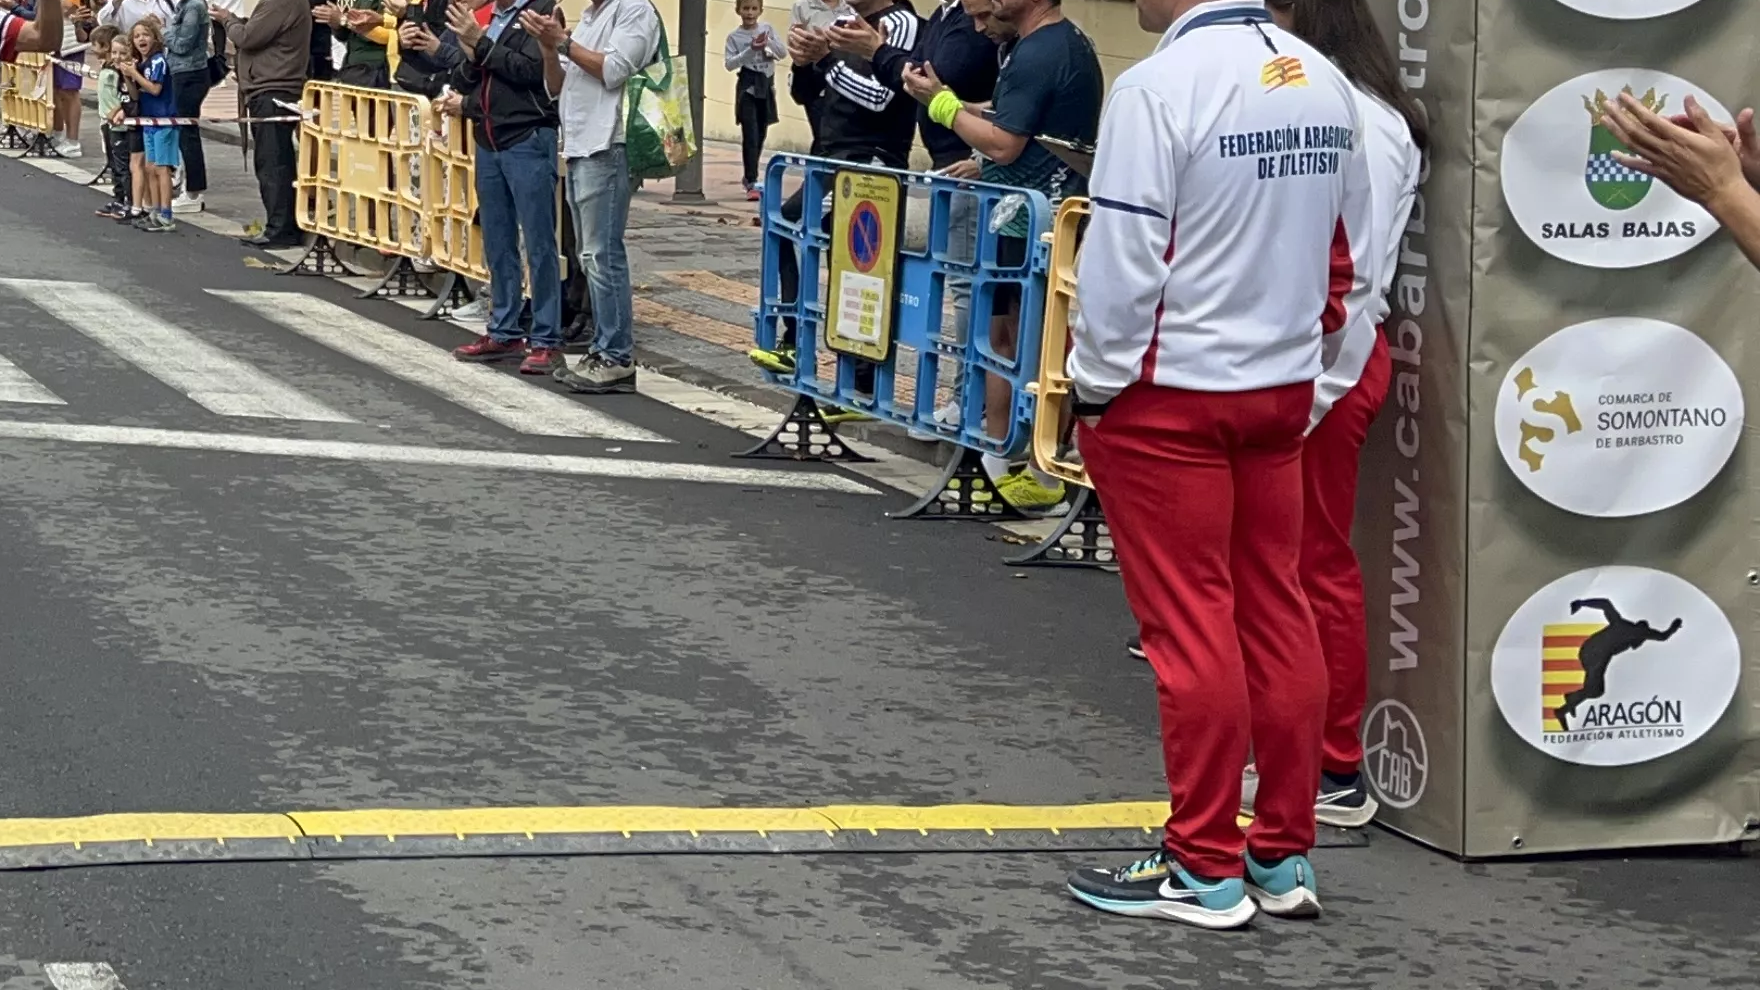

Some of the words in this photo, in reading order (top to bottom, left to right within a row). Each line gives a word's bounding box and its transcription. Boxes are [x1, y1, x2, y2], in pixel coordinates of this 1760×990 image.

[1219, 124, 1300, 158] FEDERACIÓN
[1258, 156, 1275, 180] DE
[1541, 223, 1610, 239] SALAS
[1622, 222, 1696, 238] BAJAS
[1598, 392, 1655, 405] COMARCA
[1658, 392, 1673, 403] DE
[1597, 407, 1726, 430] SOMONTANO
[1596, 437, 1611, 449] DE
[1615, 434, 1684, 447] BARBASTRO
[1582, 695, 1682, 728] ARAGÓN
[1543, 730, 1614, 744] FEDERACIÓN
[1618, 728, 1685, 741] ATLETISMO
[1377, 747, 1412, 799] CAB
